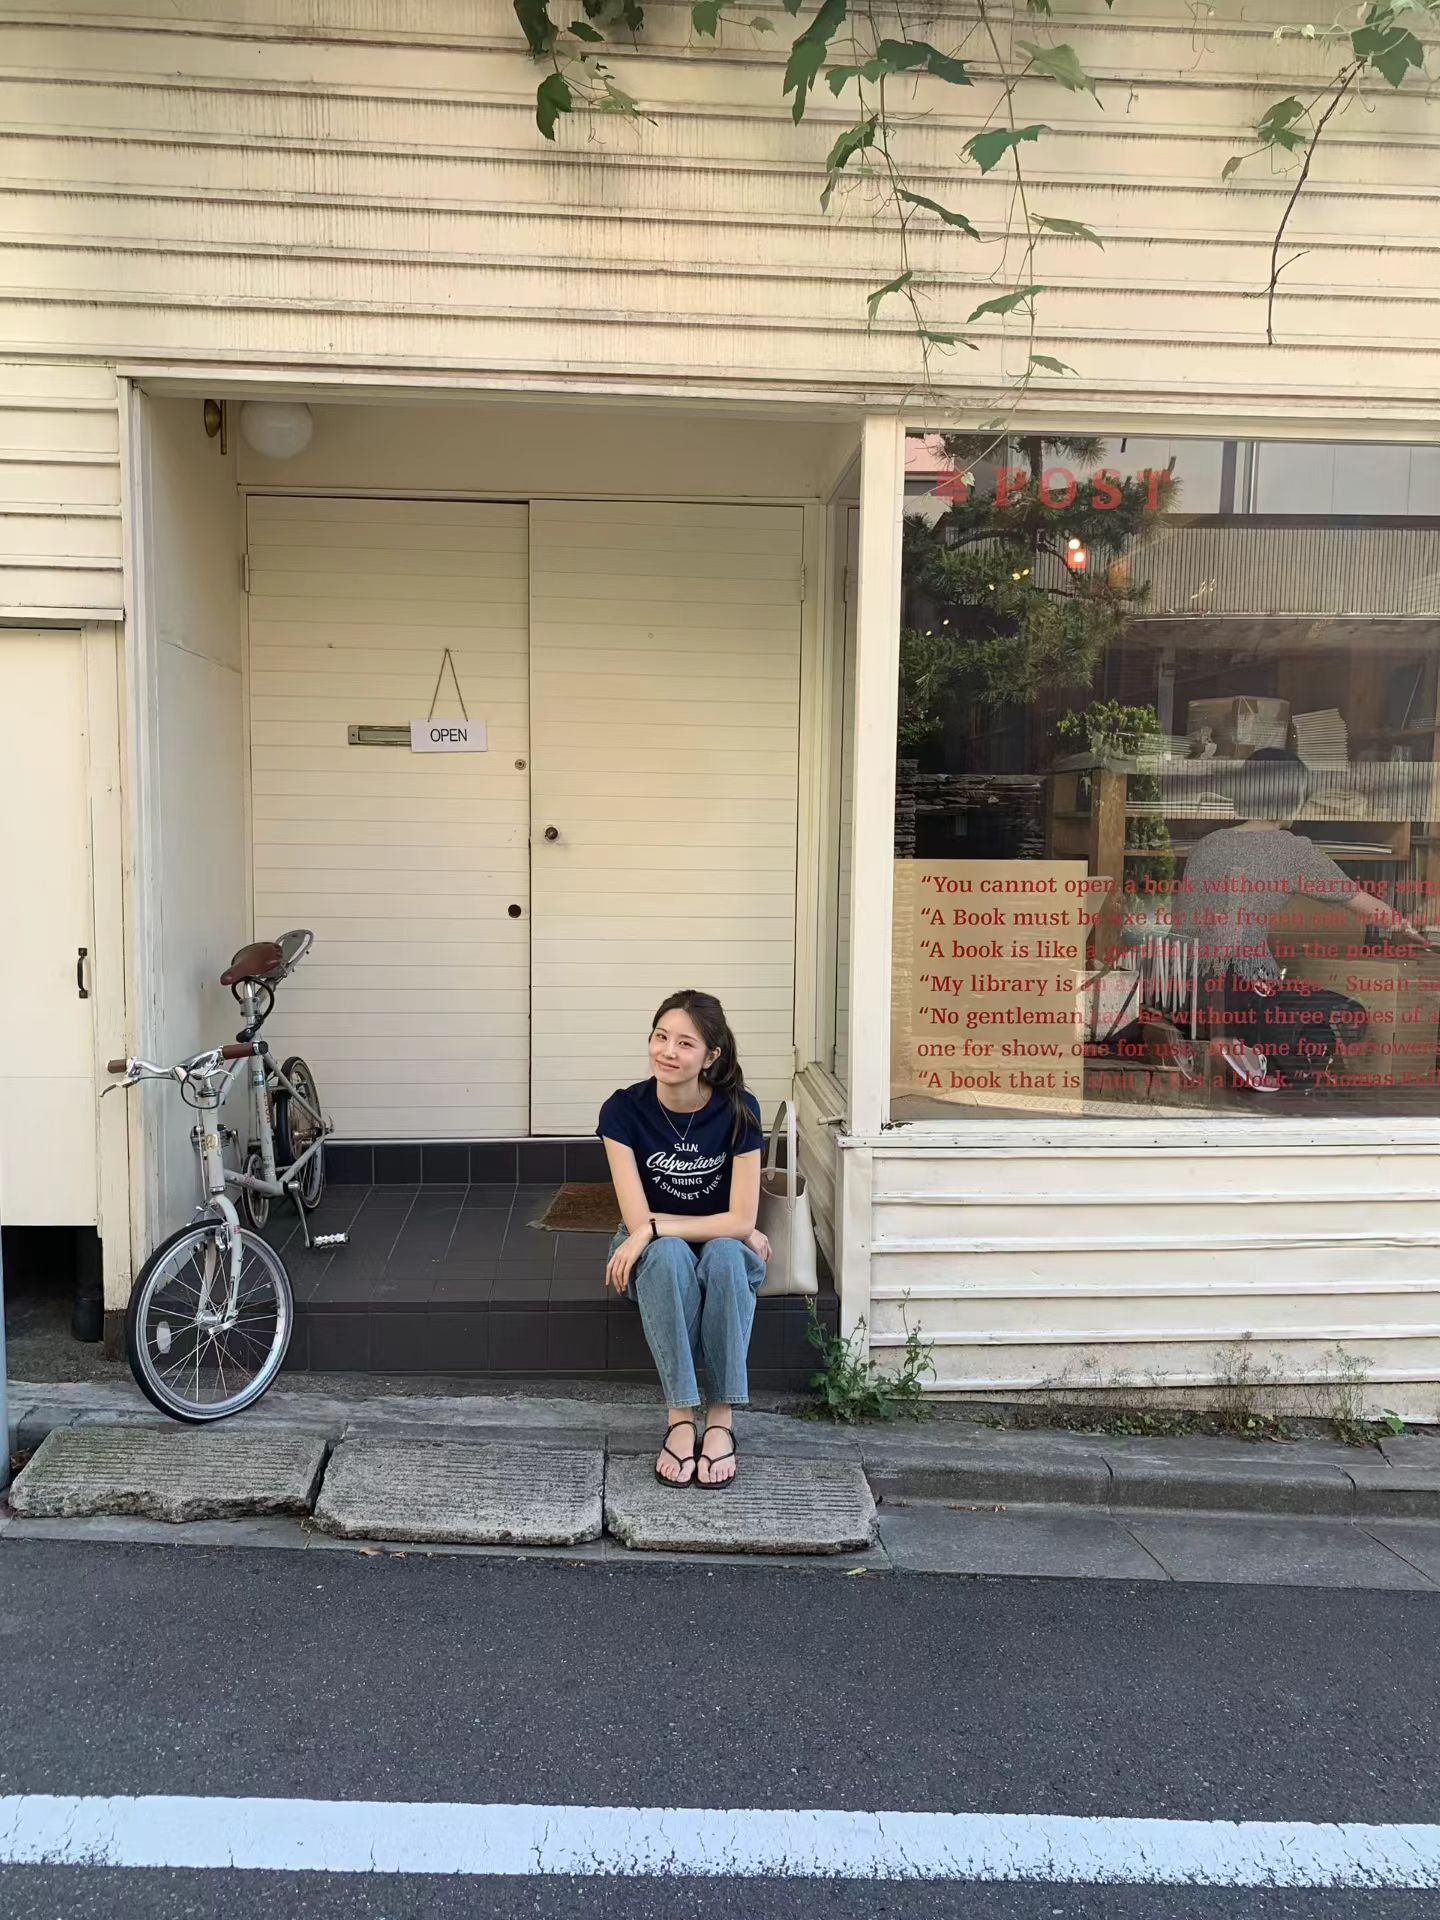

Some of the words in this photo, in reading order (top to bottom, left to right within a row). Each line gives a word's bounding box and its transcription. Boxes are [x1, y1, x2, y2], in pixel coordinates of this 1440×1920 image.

[992, 466, 1171, 510] POST
[430, 728, 468, 742] OPEN
[921, 875, 973, 893] “You
[980, 876, 1057, 893] cannot
[1064, 879, 1115, 897] open
[1124, 879, 1137, 893] a
[1203, 875, 1288, 893] without
[1297, 874, 1389, 898] learning
[921, 907, 945, 926] “A
[953, 907, 1006, 926] Book
[1013, 909, 1070, 926] must
[1077, 907, 1103, 926] be
[1154, 907, 1187, 926] for
[1192, 907, 1228, 926] the
[920, 940, 945, 958] “A
[952, 940, 1004, 958] book
[1010, 940, 1029, 958] is
[1036, 940, 1078, 958] like
[1274, 940, 1296, 958] in
[1303, 942, 1338, 959] the
[919, 975, 964, 997] “My
[970, 974, 1048, 996] library
[1056, 974, 1073, 992] is
[1204, 972, 1228, 993] of
[1346, 975, 1410, 992] Susan
[919, 1006, 960, 1024] “No
[966, 1006, 1084, 1029] gentleman
[1170, 1006, 1257, 1024] without
[1264, 1006, 1323, 1024] three
[1329, 1006, 1394, 1029] copies
[1402, 1006, 1423, 1024] of
[917, 1042, 955, 1057] one
[963, 1039, 994, 1057] for
[1001, 1039, 1063, 1059] show,
[1071, 1042, 1110, 1057] one
[1116, 1038, 1149, 1057] for
[1251, 1042, 1290, 1056] one
[1296, 1037, 1328, 1056] for
[918, 1071, 943, 1089] “A
[951, 1071, 1002, 1089] book
[1008, 1071, 1056, 1089] that
[1062, 1071, 1080, 1089] is
[1213, 1074, 1225, 1088] a
[652, 1175, 661, 1184] A
[660, 1181, 700, 1200] SUNSET
[702, 1174, 723, 1195] VIBE
[671, 1177, 703, 1186] BRING
